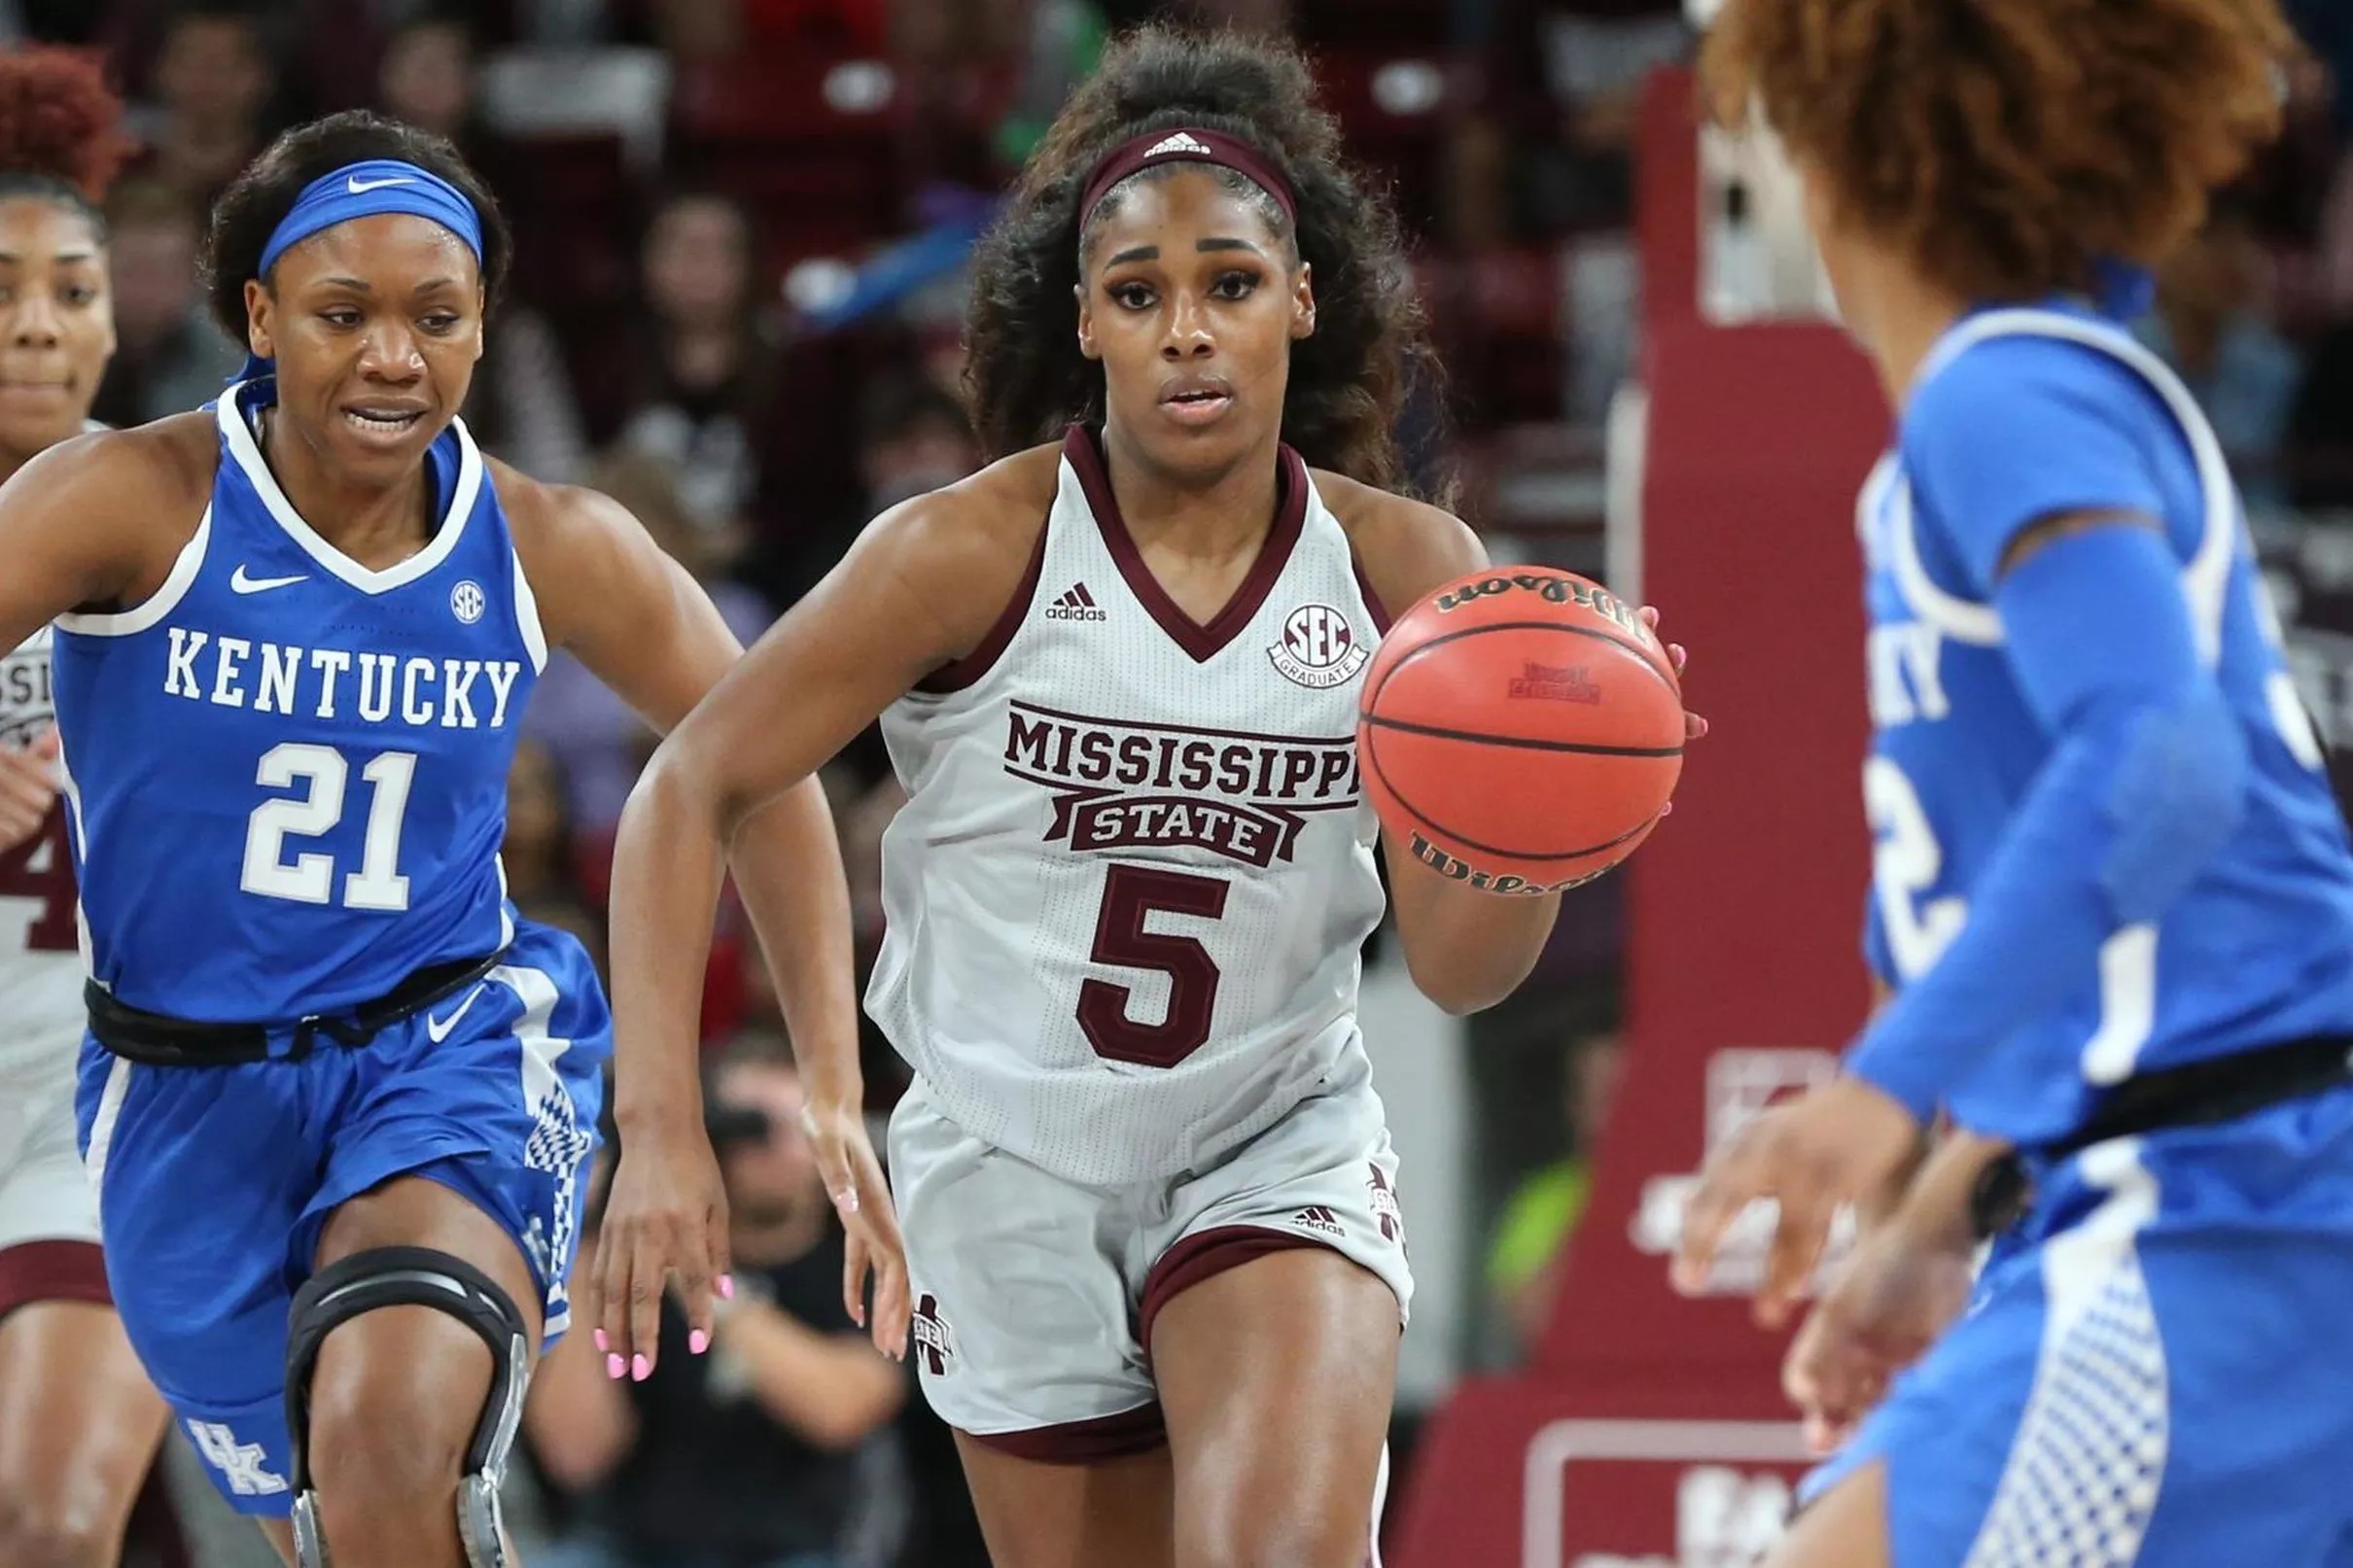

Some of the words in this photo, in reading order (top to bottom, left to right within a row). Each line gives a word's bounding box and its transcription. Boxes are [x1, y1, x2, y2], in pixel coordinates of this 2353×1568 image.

[453, 583, 482, 620] SEC
[1045, 605, 1106, 621] adidas
[1285, 606, 1349, 666] SEC
[163, 626, 520, 729] KENTUCKY
[1279, 658, 1355, 685] GRADUATE
[239, 743, 418, 911] 21
[1091, 803, 1264, 856] STATE
[1076, 863, 1231, 1069] 5
